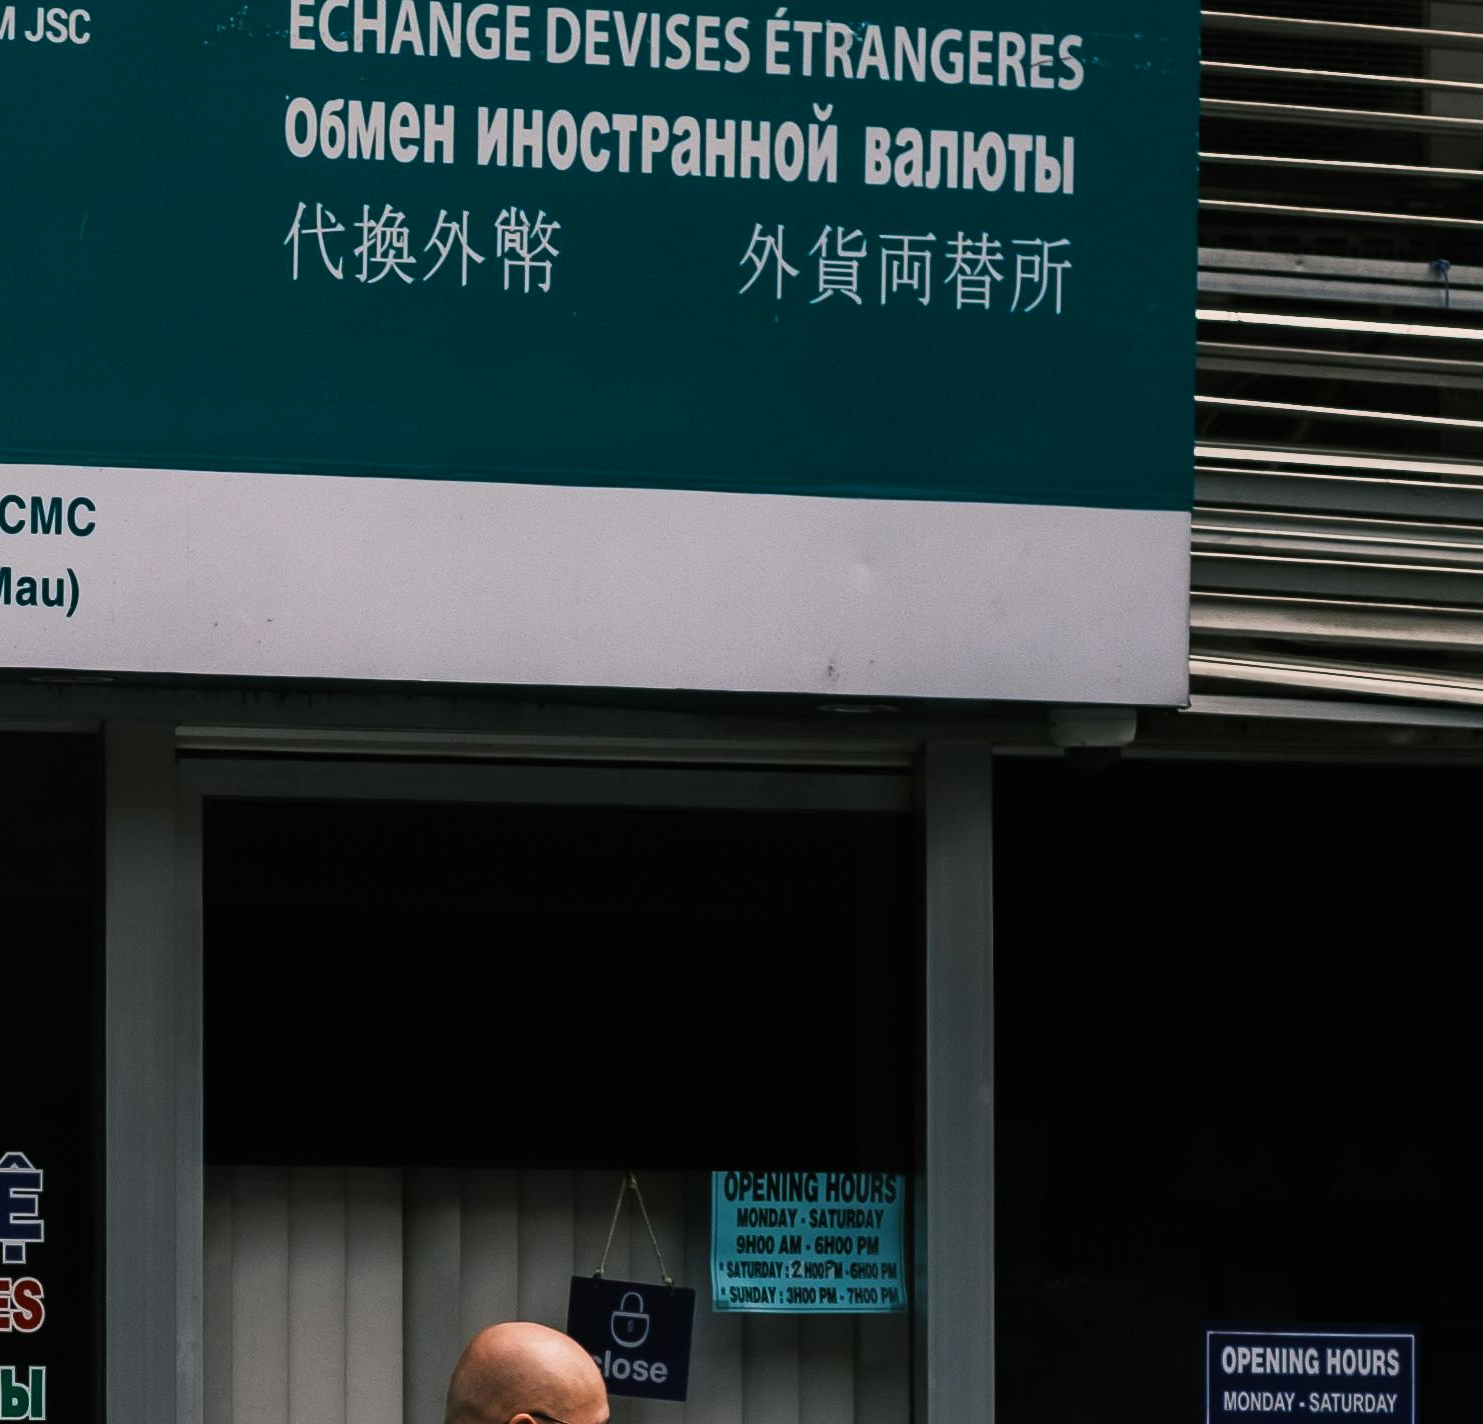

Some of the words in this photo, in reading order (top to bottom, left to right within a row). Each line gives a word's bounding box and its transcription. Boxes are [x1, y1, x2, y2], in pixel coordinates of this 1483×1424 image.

[24, 7, 91, 44] JSC
[545, 7, 751, 74] DEVISES
[765, 7, 1085, 91] ÉTRANGERES
[864, 126, 1074, 195] валюты
[282, 202, 562, 294] 代換外幣
[738, 223, 1072, 315] 外貨両替所
[723, 1172, 819, 1202] OPENING
[825, 1173, 898, 1204] HOURS
[737, 1207, 798, 1228] MONDAY
[809, 1208, 884, 1230] SATURDAY
[736, 1235, 775, 1255] 9H00
[778, 1235, 803, 1255] AM
[815, 1235, 853, 1255] 6H00
[857, 1236, 880, 1256] PM
[726, 1261, 784, 1279] SATURDAY
[881, 1262, 898, 1280] PM
[730, 1286, 776, 1304] SUNDAY
[787, 1286, 817, 1304] 3H00
[819, 1287, 837, 1304] PM
[847, 1287, 878, 1304] 7H00
[881, 1287, 899, 1305] PM
[594, 1350, 668, 1384] lose
[1221, 1345, 1320, 1375] OPENING
[1326, 1348, 1400, 1376] HOURS
[1223, 1391, 1295, 1412] MONDAY
[1309, 1393, 1397, 1413] SATURDAY
